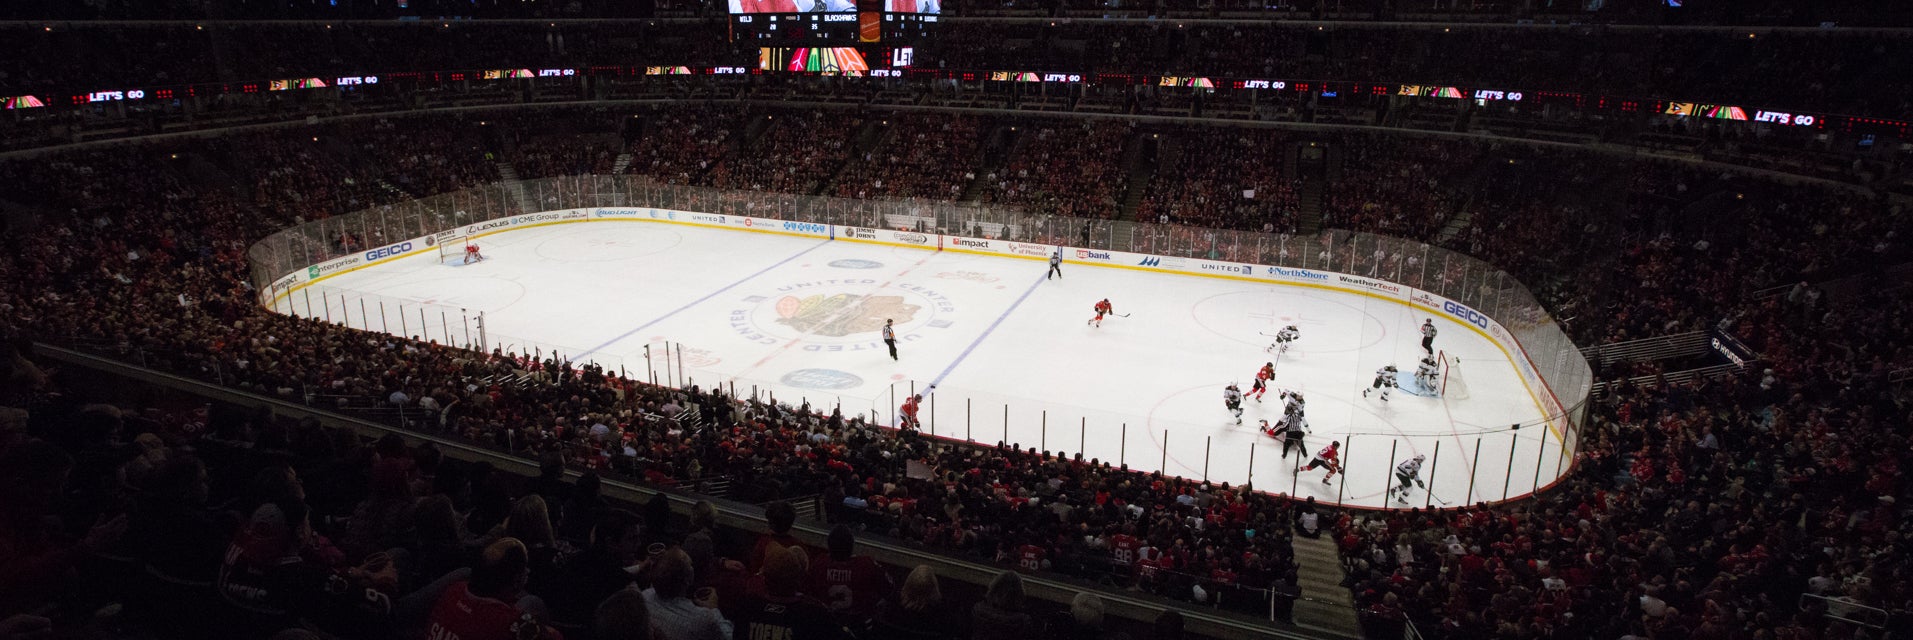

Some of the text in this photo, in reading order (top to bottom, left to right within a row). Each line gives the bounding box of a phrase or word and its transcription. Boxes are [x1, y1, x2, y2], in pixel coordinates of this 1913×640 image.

[337, 76, 378, 86] LET'S GO
[1044, 74, 1066, 82] LET'S
[1244, 80, 1285, 89] LET'S GO
[89, 90, 144, 102] LET'S GO
[1475, 90, 1522, 101] LET'S GO
[1755, 110, 1814, 126] LET'S GO
[518, 216, 536, 224] CME
[536, 213, 560, 222] Group
[476, 221, 509, 232] LEXUS
[960, 239, 989, 249] impact
[1018, 243, 1046, 252] University
[366, 242, 412, 262] GEICO
[1202, 264, 1240, 272] UNITED
[1275, 268, 1328, 280] NorthShore
[1340, 276, 1400, 292] WeatherTech
[777, 278, 954, 314] UNITED CENTER
[1444, 300, 1488, 329] GEICO
[802, 332, 923, 352] UITED
[826, 568, 852, 582] KEITH
